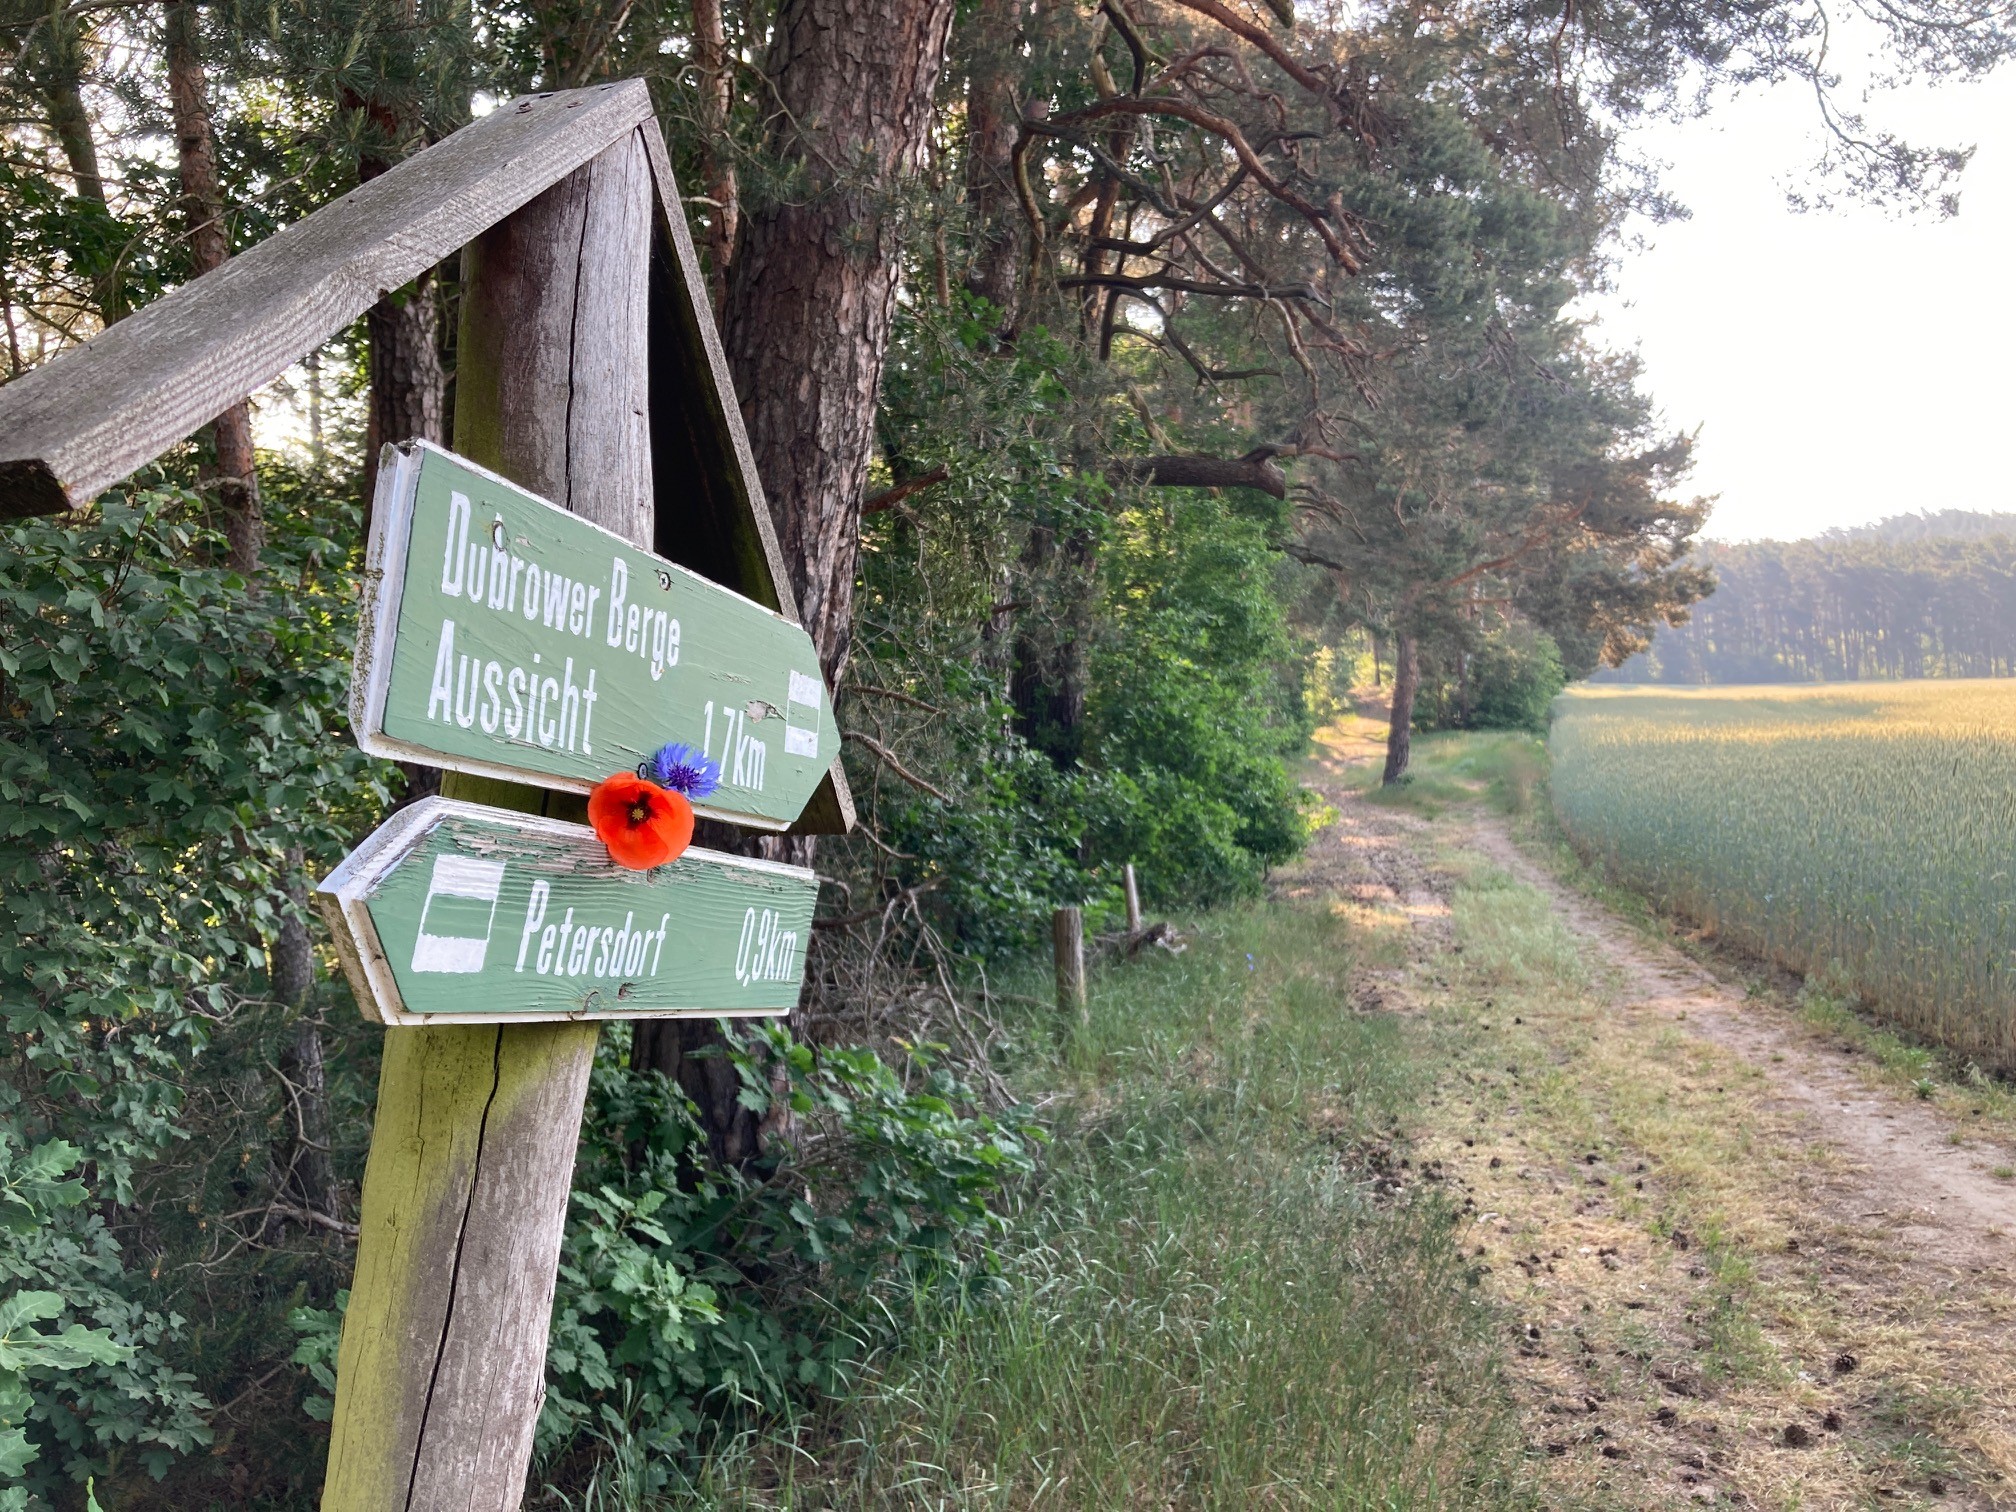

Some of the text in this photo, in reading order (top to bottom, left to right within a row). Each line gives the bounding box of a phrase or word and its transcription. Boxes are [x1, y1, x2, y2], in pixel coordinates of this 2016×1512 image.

[441, 490, 681, 681] Dubrower Berge
[427, 618, 598, 756] Aussicht
[515, 879, 797, 987] Petersdorf 0,9km
